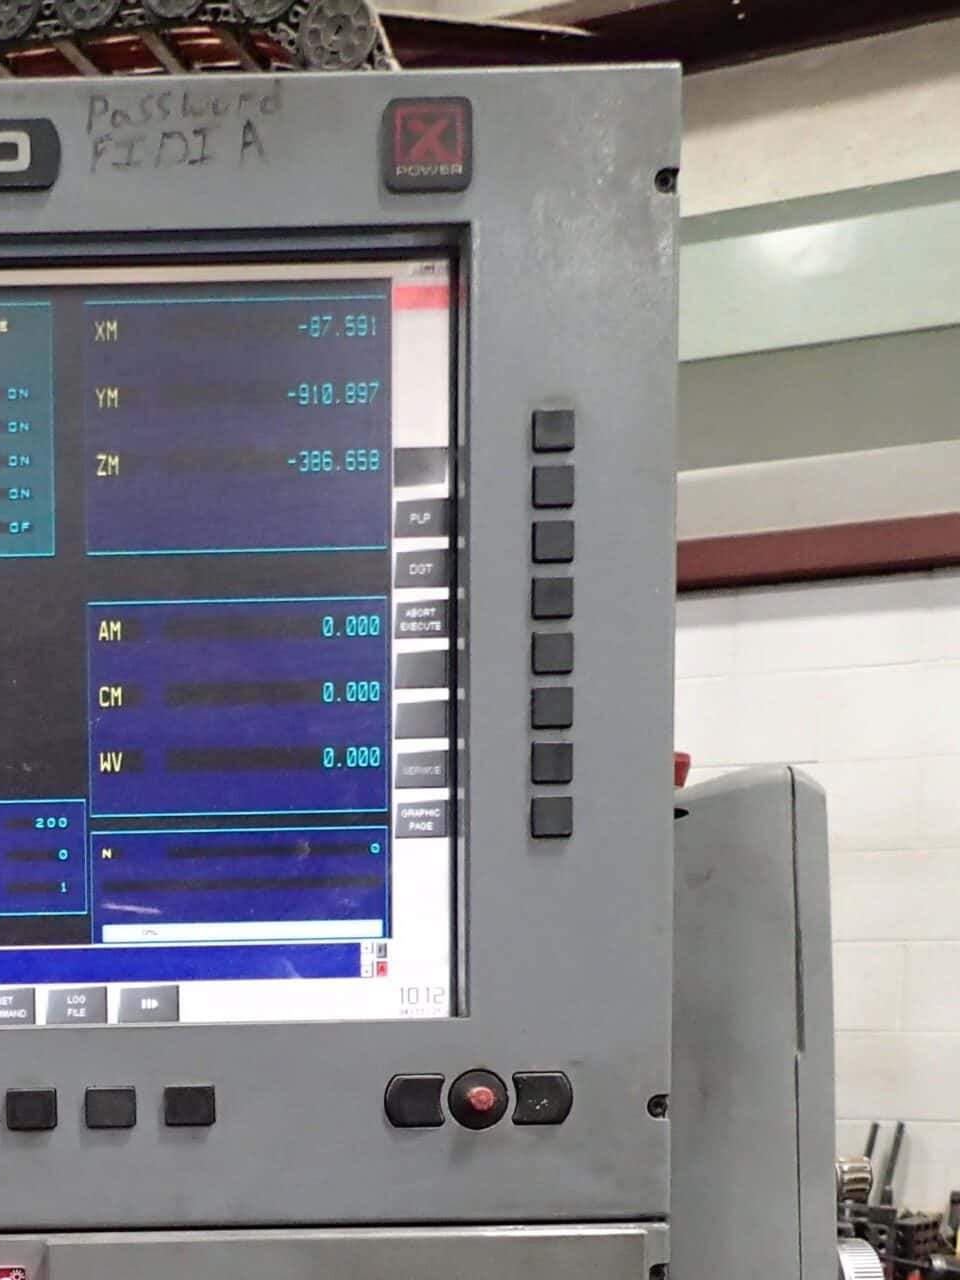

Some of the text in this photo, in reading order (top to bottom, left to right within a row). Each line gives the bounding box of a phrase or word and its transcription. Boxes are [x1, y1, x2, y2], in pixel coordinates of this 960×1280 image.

[396, 164, 463, 176] POWER
[95, 320, 118, 342] XM
[7, 388, 28, 399] ON
[96, 387, 118, 409] YM
[8, 422, 29, 433] ON
[8, 456, 29, 466] ON
[97, 454, 119, 476] ZM
[8, 488, 30, 499] ON
[98, 616, 379, 641] AM 0.000
[400, 622, 441, 631] EXECUTE
[99, 681, 379, 707] CM 0.000
[100, 747, 380, 772] WV 0.000
[36, 817, 67, 828] 200
[409, 822, 433, 831] PAGE
[59, 849, 68, 860] 0
[102, 843, 380, 859] N 0
[60, 883, 67, 892] 1
[67, 1009, 85, 1017] FILE
